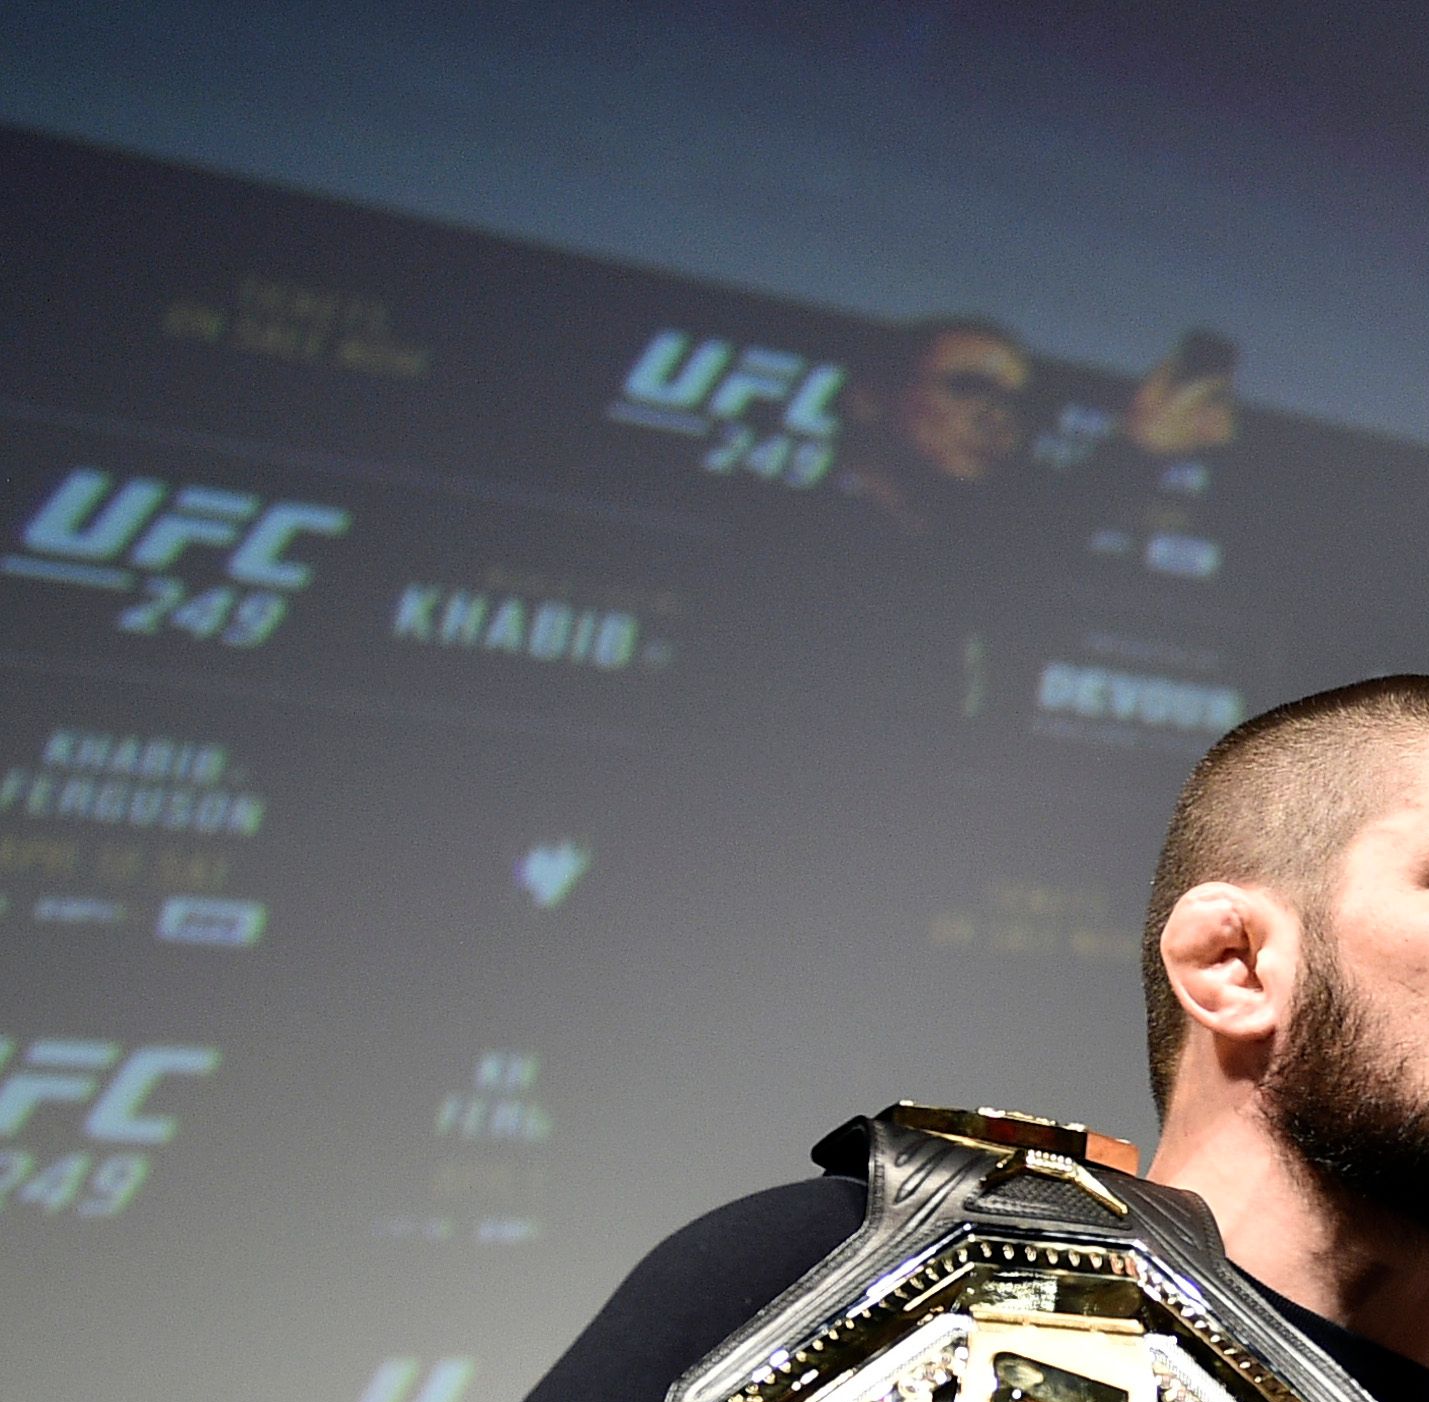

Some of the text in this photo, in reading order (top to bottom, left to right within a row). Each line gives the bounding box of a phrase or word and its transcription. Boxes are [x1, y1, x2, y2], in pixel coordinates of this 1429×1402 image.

[22, 466, 352, 588] UFC
[117, 573, 289, 647] 249
[394, 582, 640, 671] KHABIB
[0, 1036, 222, 1145] FC
